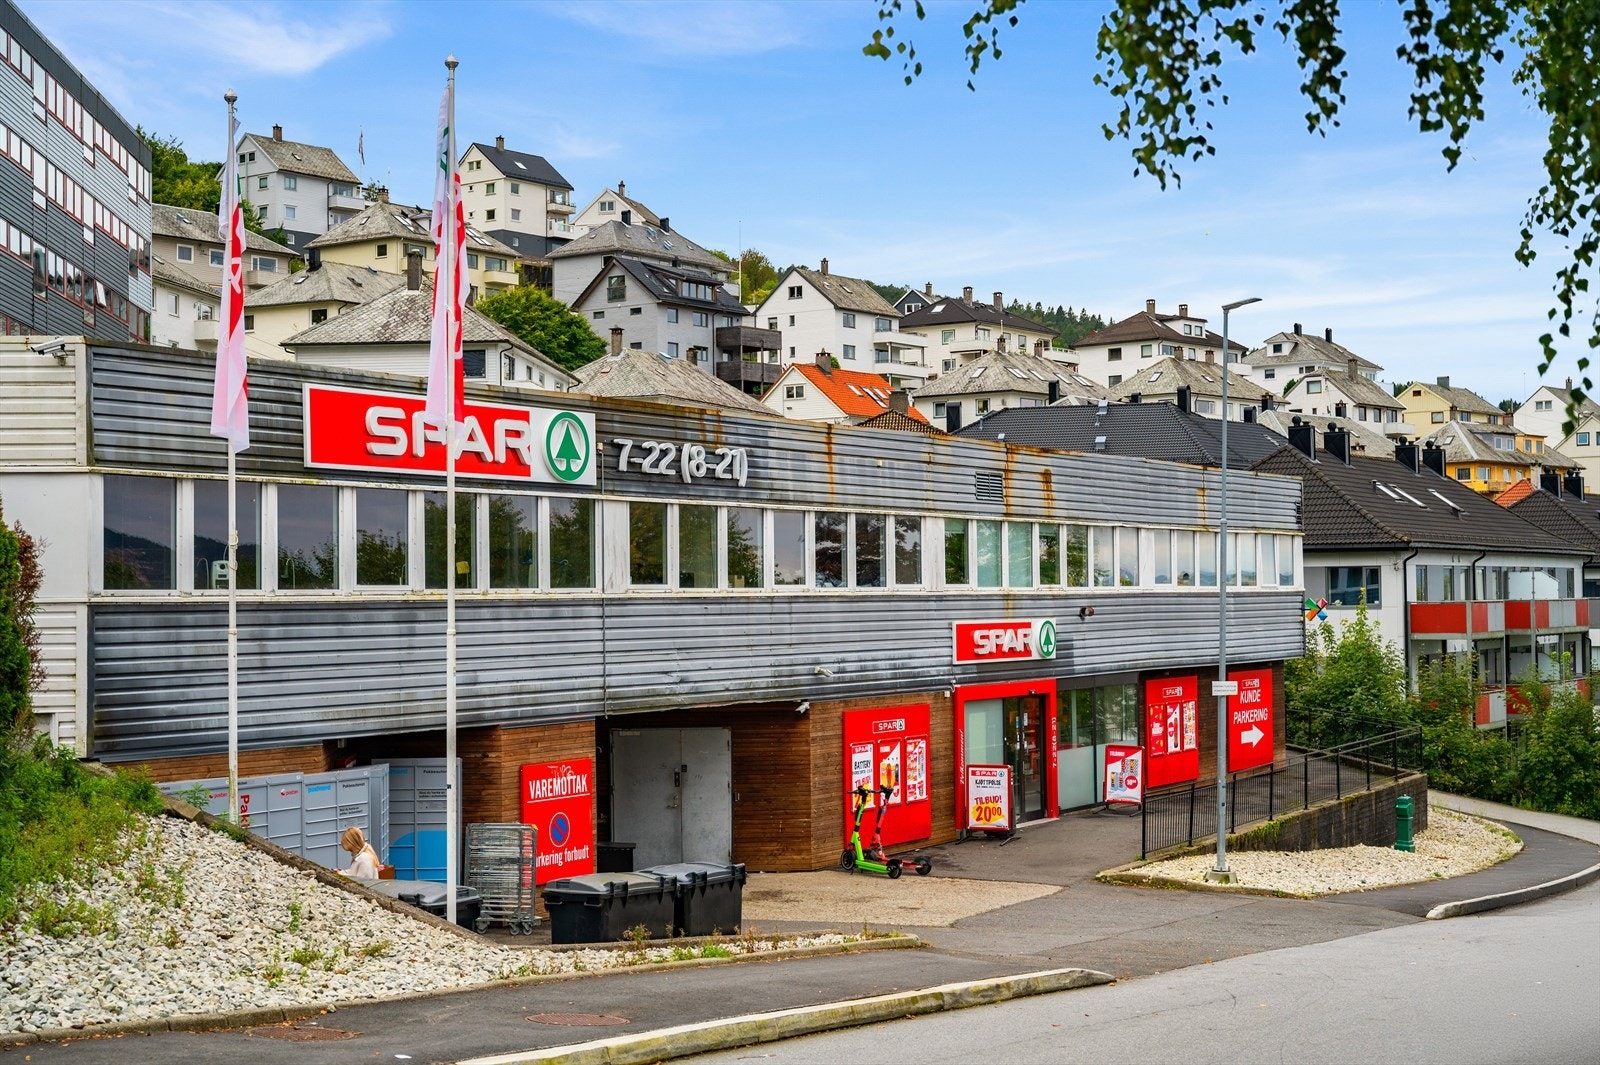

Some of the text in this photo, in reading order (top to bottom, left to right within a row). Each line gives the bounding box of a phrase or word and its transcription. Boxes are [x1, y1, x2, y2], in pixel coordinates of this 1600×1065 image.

[365, 405, 532, 466] SPAR
[613, 438, 748, 487] 7-22 (8-21)
[973, 628, 1033, 655] SPAR
[1166, 688, 1178, 696] SPAR
[1240, 690, 1261, 704] KUNDE
[1233, 708, 1268, 725] PARKERING
[878, 722, 897, 731] SPAR
[855, 745, 869, 753] SPAR
[854, 760, 871, 770] BATTERY
[529, 774, 588, 800] VAREMOTTAK
[974, 795, 1002, 806] TILBUD!
[564, 845, 589, 863] forbudt
